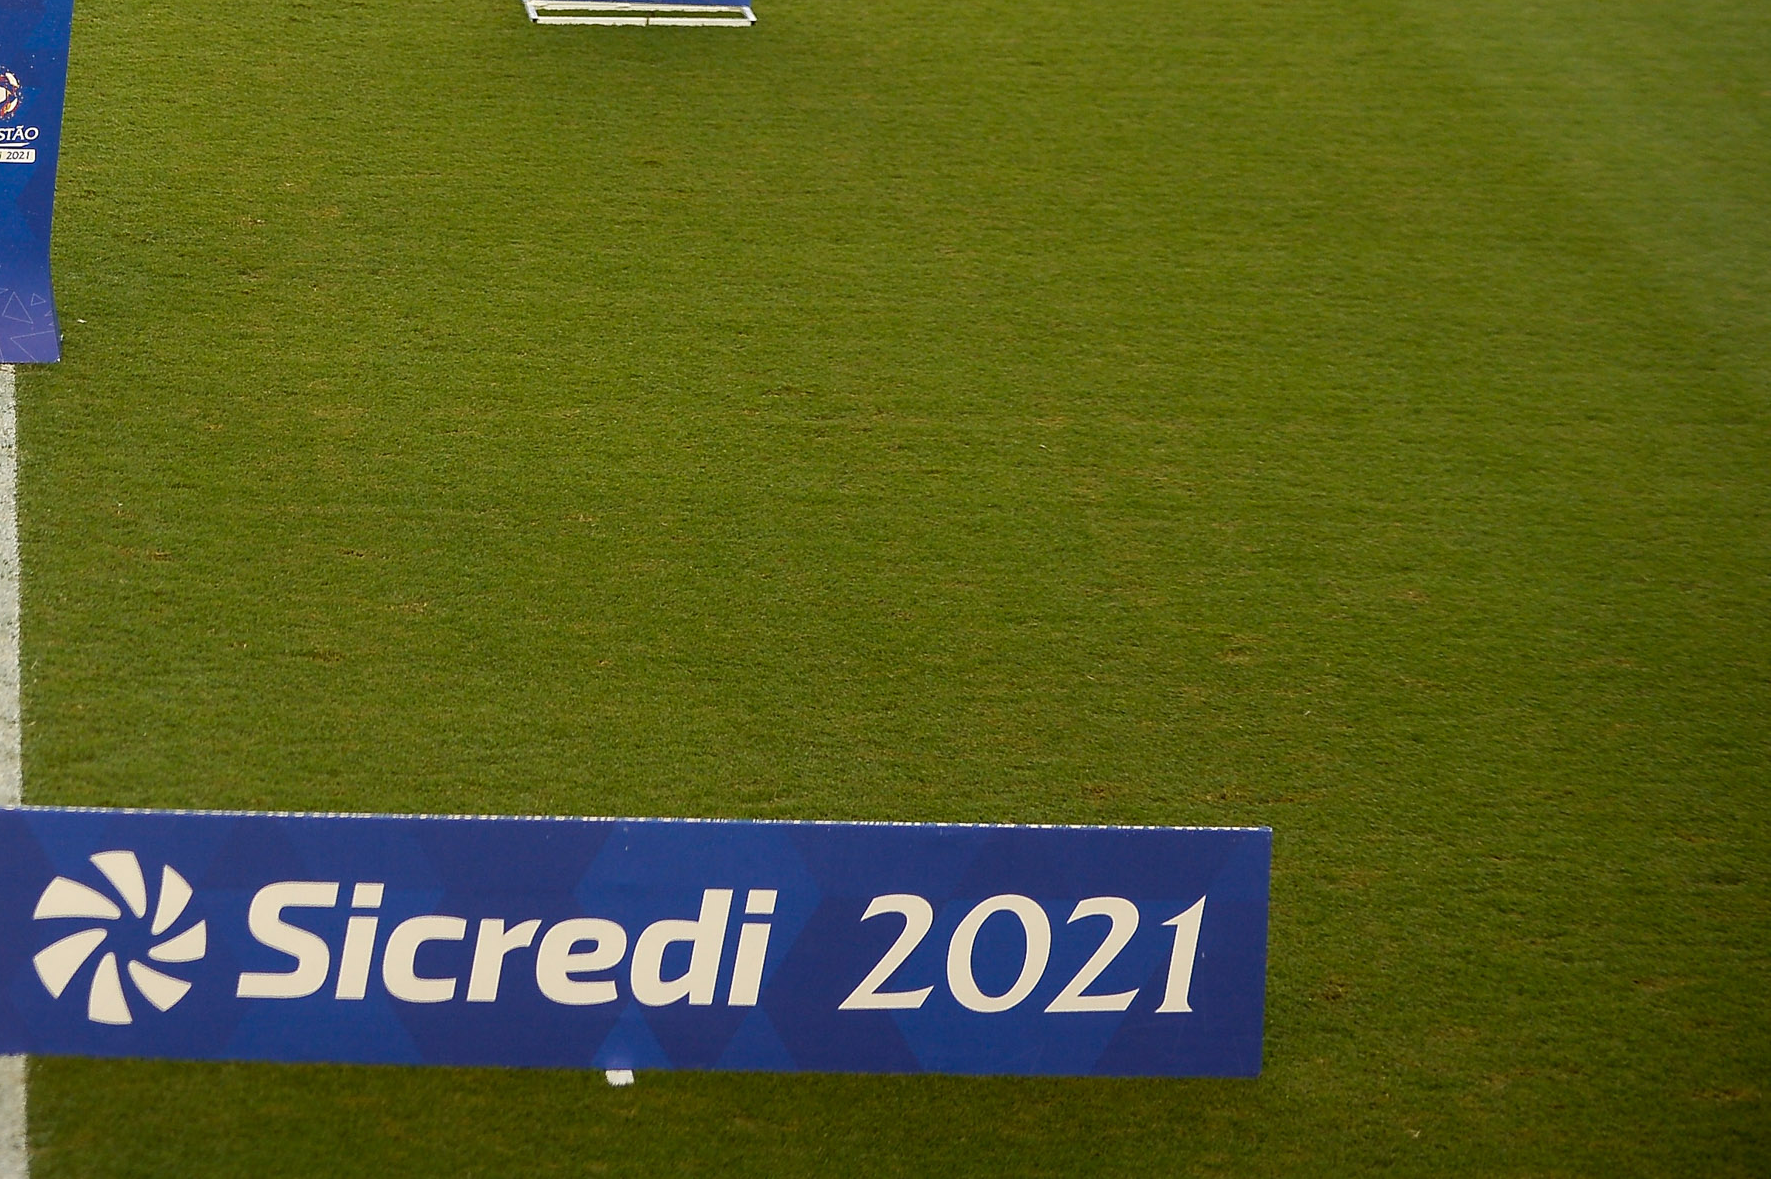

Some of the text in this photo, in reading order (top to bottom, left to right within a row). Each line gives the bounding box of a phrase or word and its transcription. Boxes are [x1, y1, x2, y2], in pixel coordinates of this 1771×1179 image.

[6, 151, 30, 160] 2021
[236, 881, 778, 1007] Sicredi
[838, 893, 1207, 1013] 2021
